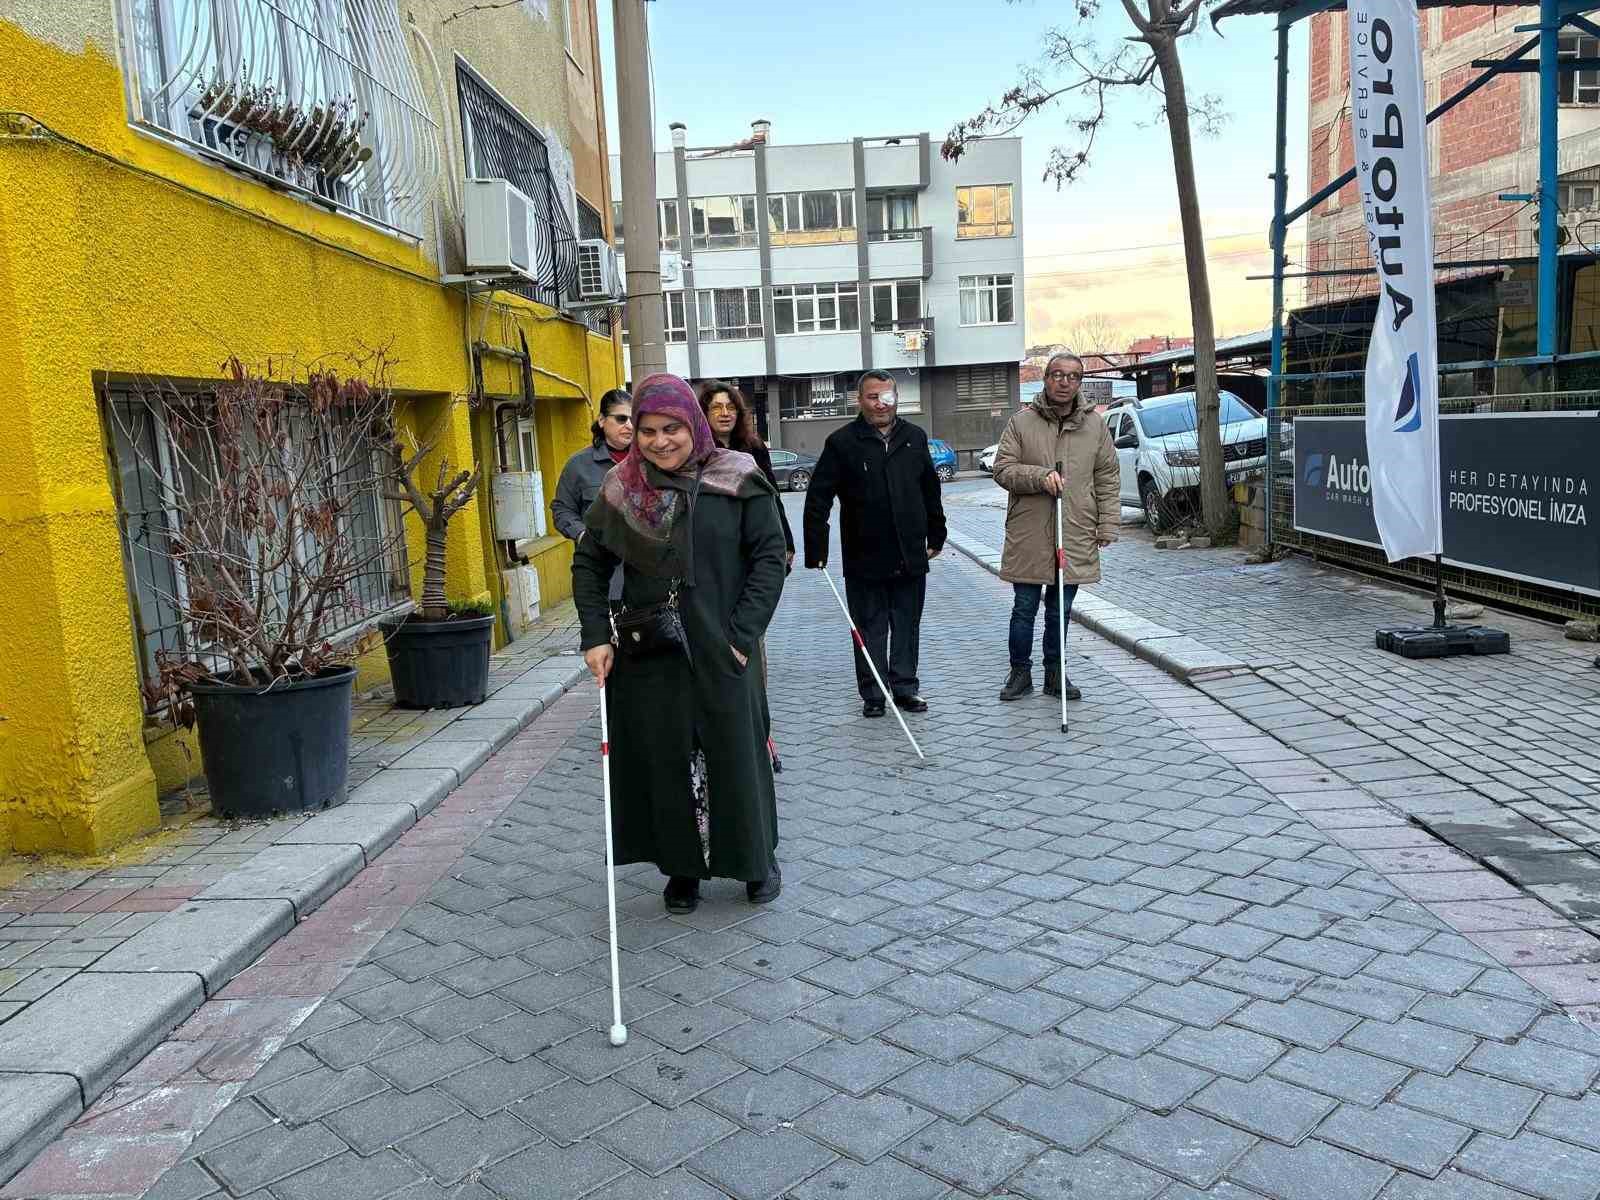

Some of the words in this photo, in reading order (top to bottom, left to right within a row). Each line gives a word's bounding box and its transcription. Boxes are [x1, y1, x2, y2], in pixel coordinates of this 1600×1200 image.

[1326, 454, 1371, 493] Auto
[1450, 470, 1477, 485] HER
[1488, 472, 1587, 496] DETAYINDA
[1449, 491, 1546, 520] PROFESYONEL
[1550, 497, 1587, 526] İMZA
